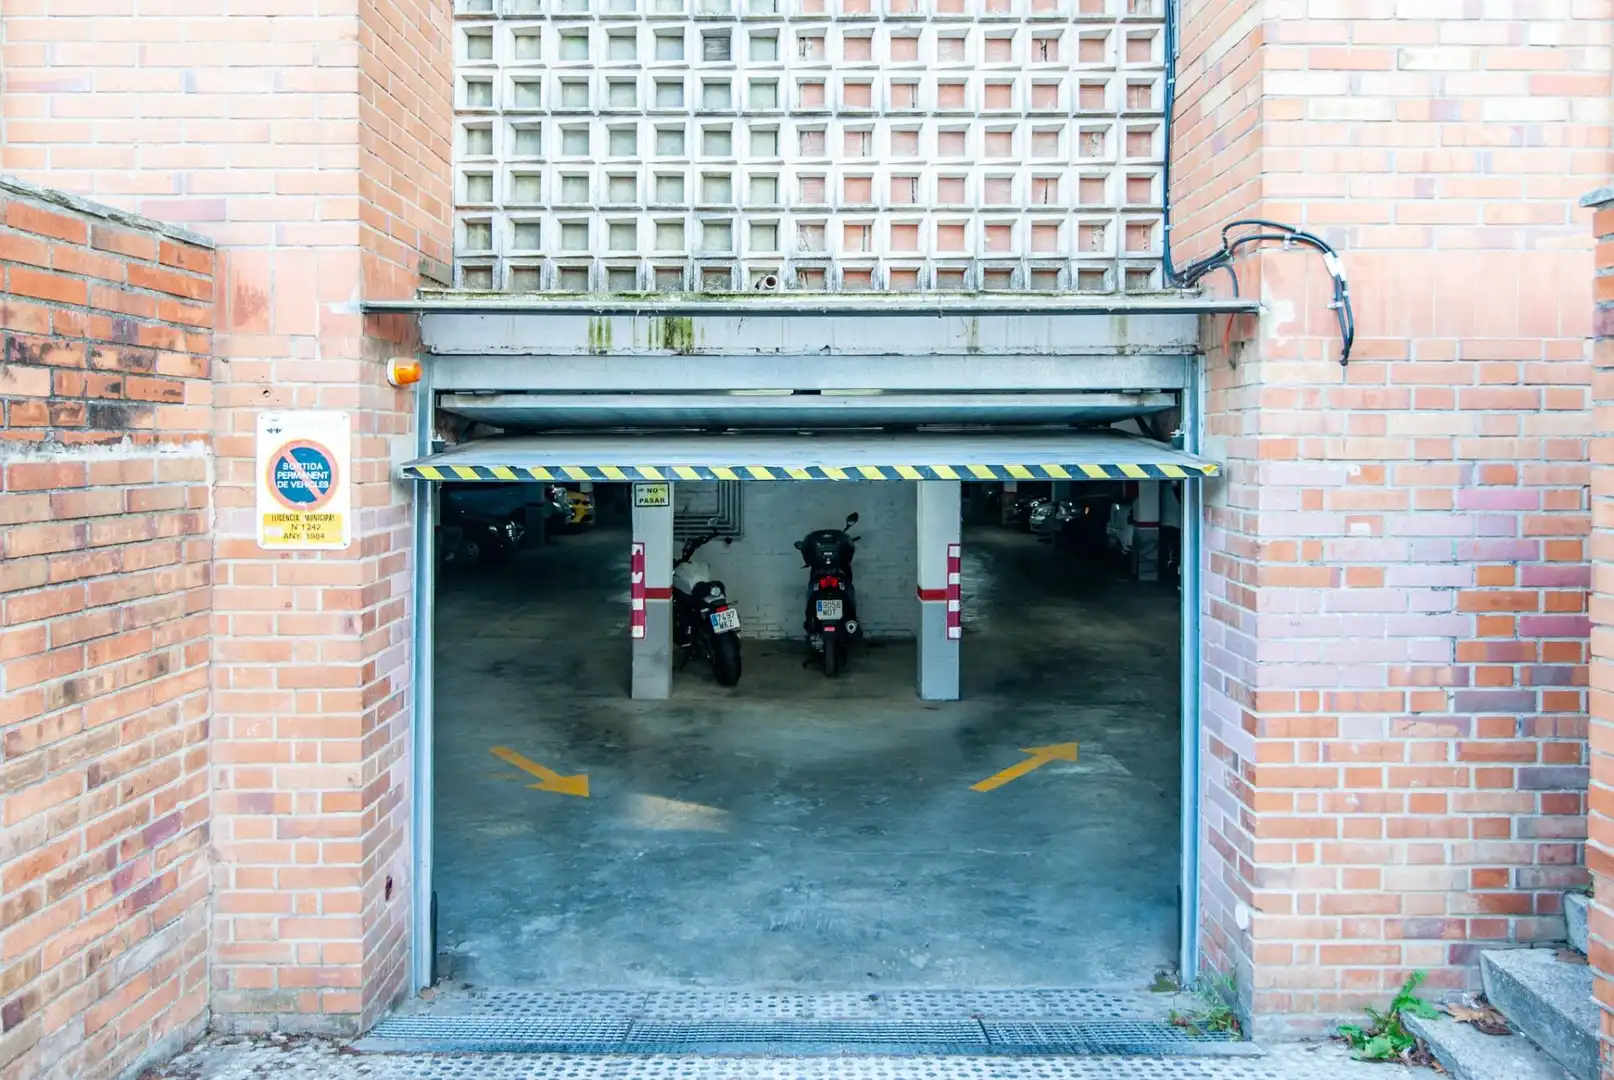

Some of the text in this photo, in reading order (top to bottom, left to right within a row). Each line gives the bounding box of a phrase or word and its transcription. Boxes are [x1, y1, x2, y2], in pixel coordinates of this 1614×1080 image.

[283, 462, 323, 470] SORTIDA
[277, 471, 328, 479] PERMANENT
[283, 532, 300, 540] ANY
